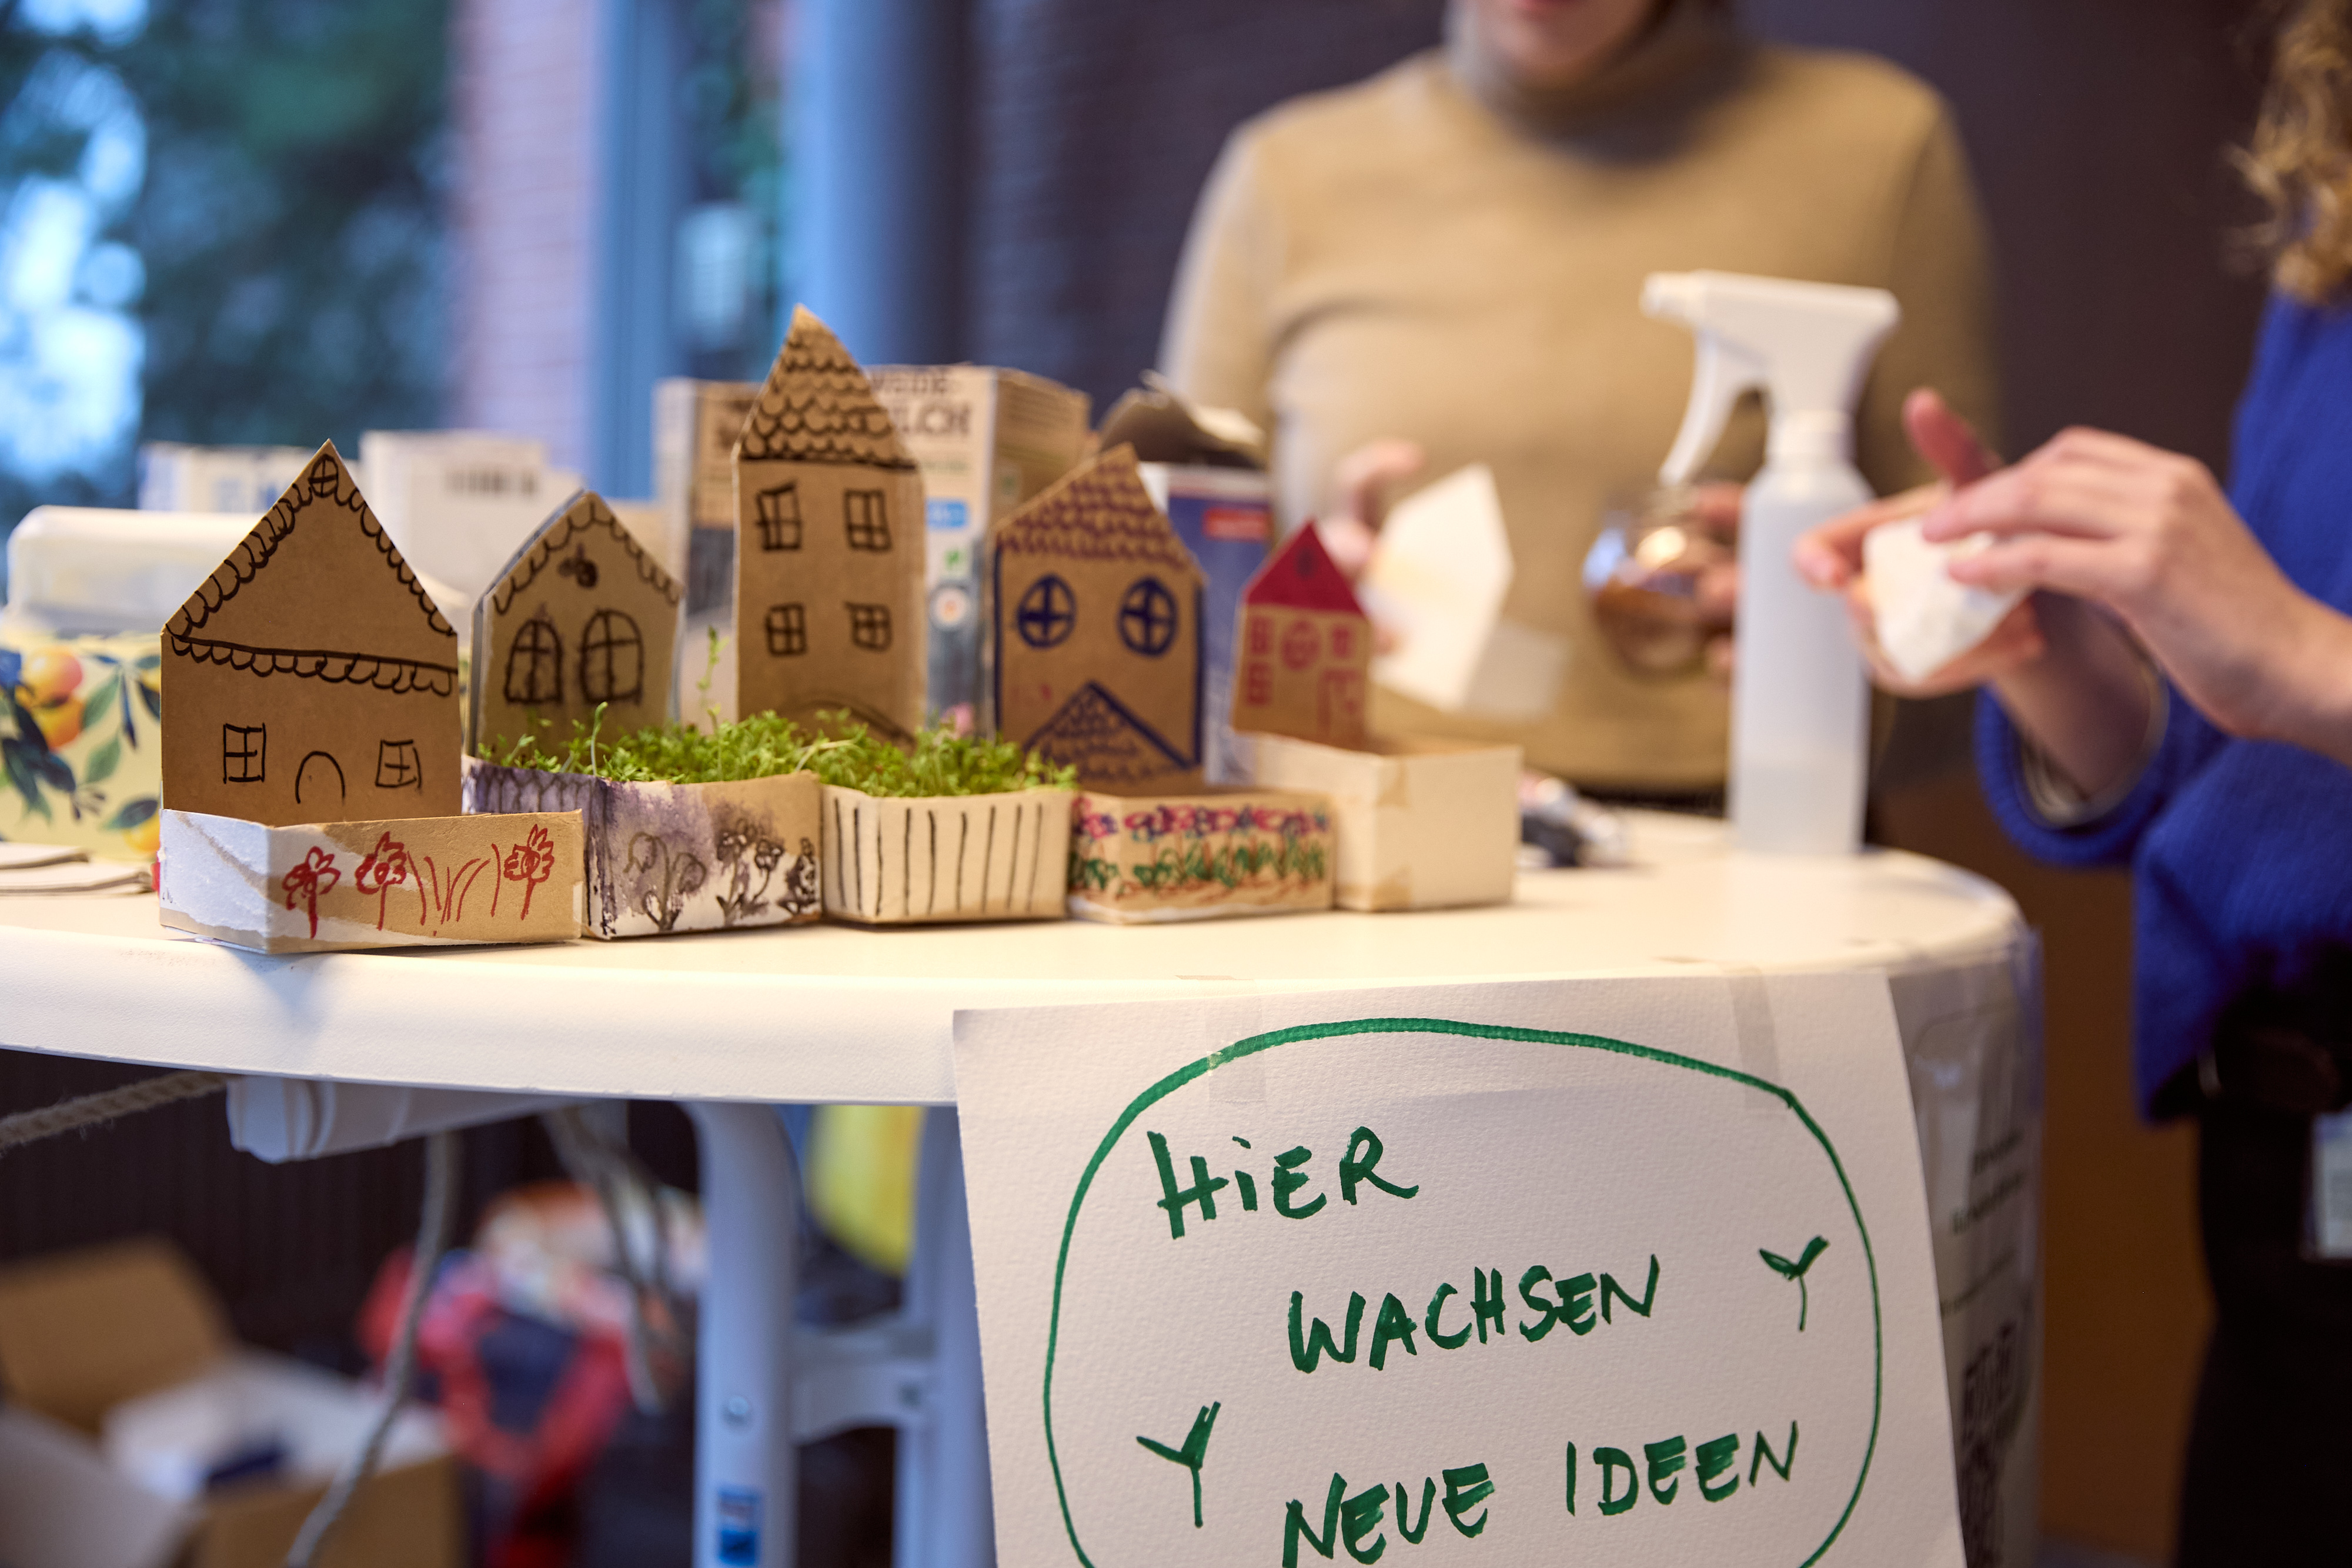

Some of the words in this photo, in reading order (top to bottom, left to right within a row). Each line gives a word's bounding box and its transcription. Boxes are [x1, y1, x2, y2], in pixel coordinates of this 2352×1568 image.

[1288, 1256, 1659, 1373] WACHSEN
[1283, 1463, 1494, 1568] NEUE
[1566, 1422, 1796, 1516] IDEEN
